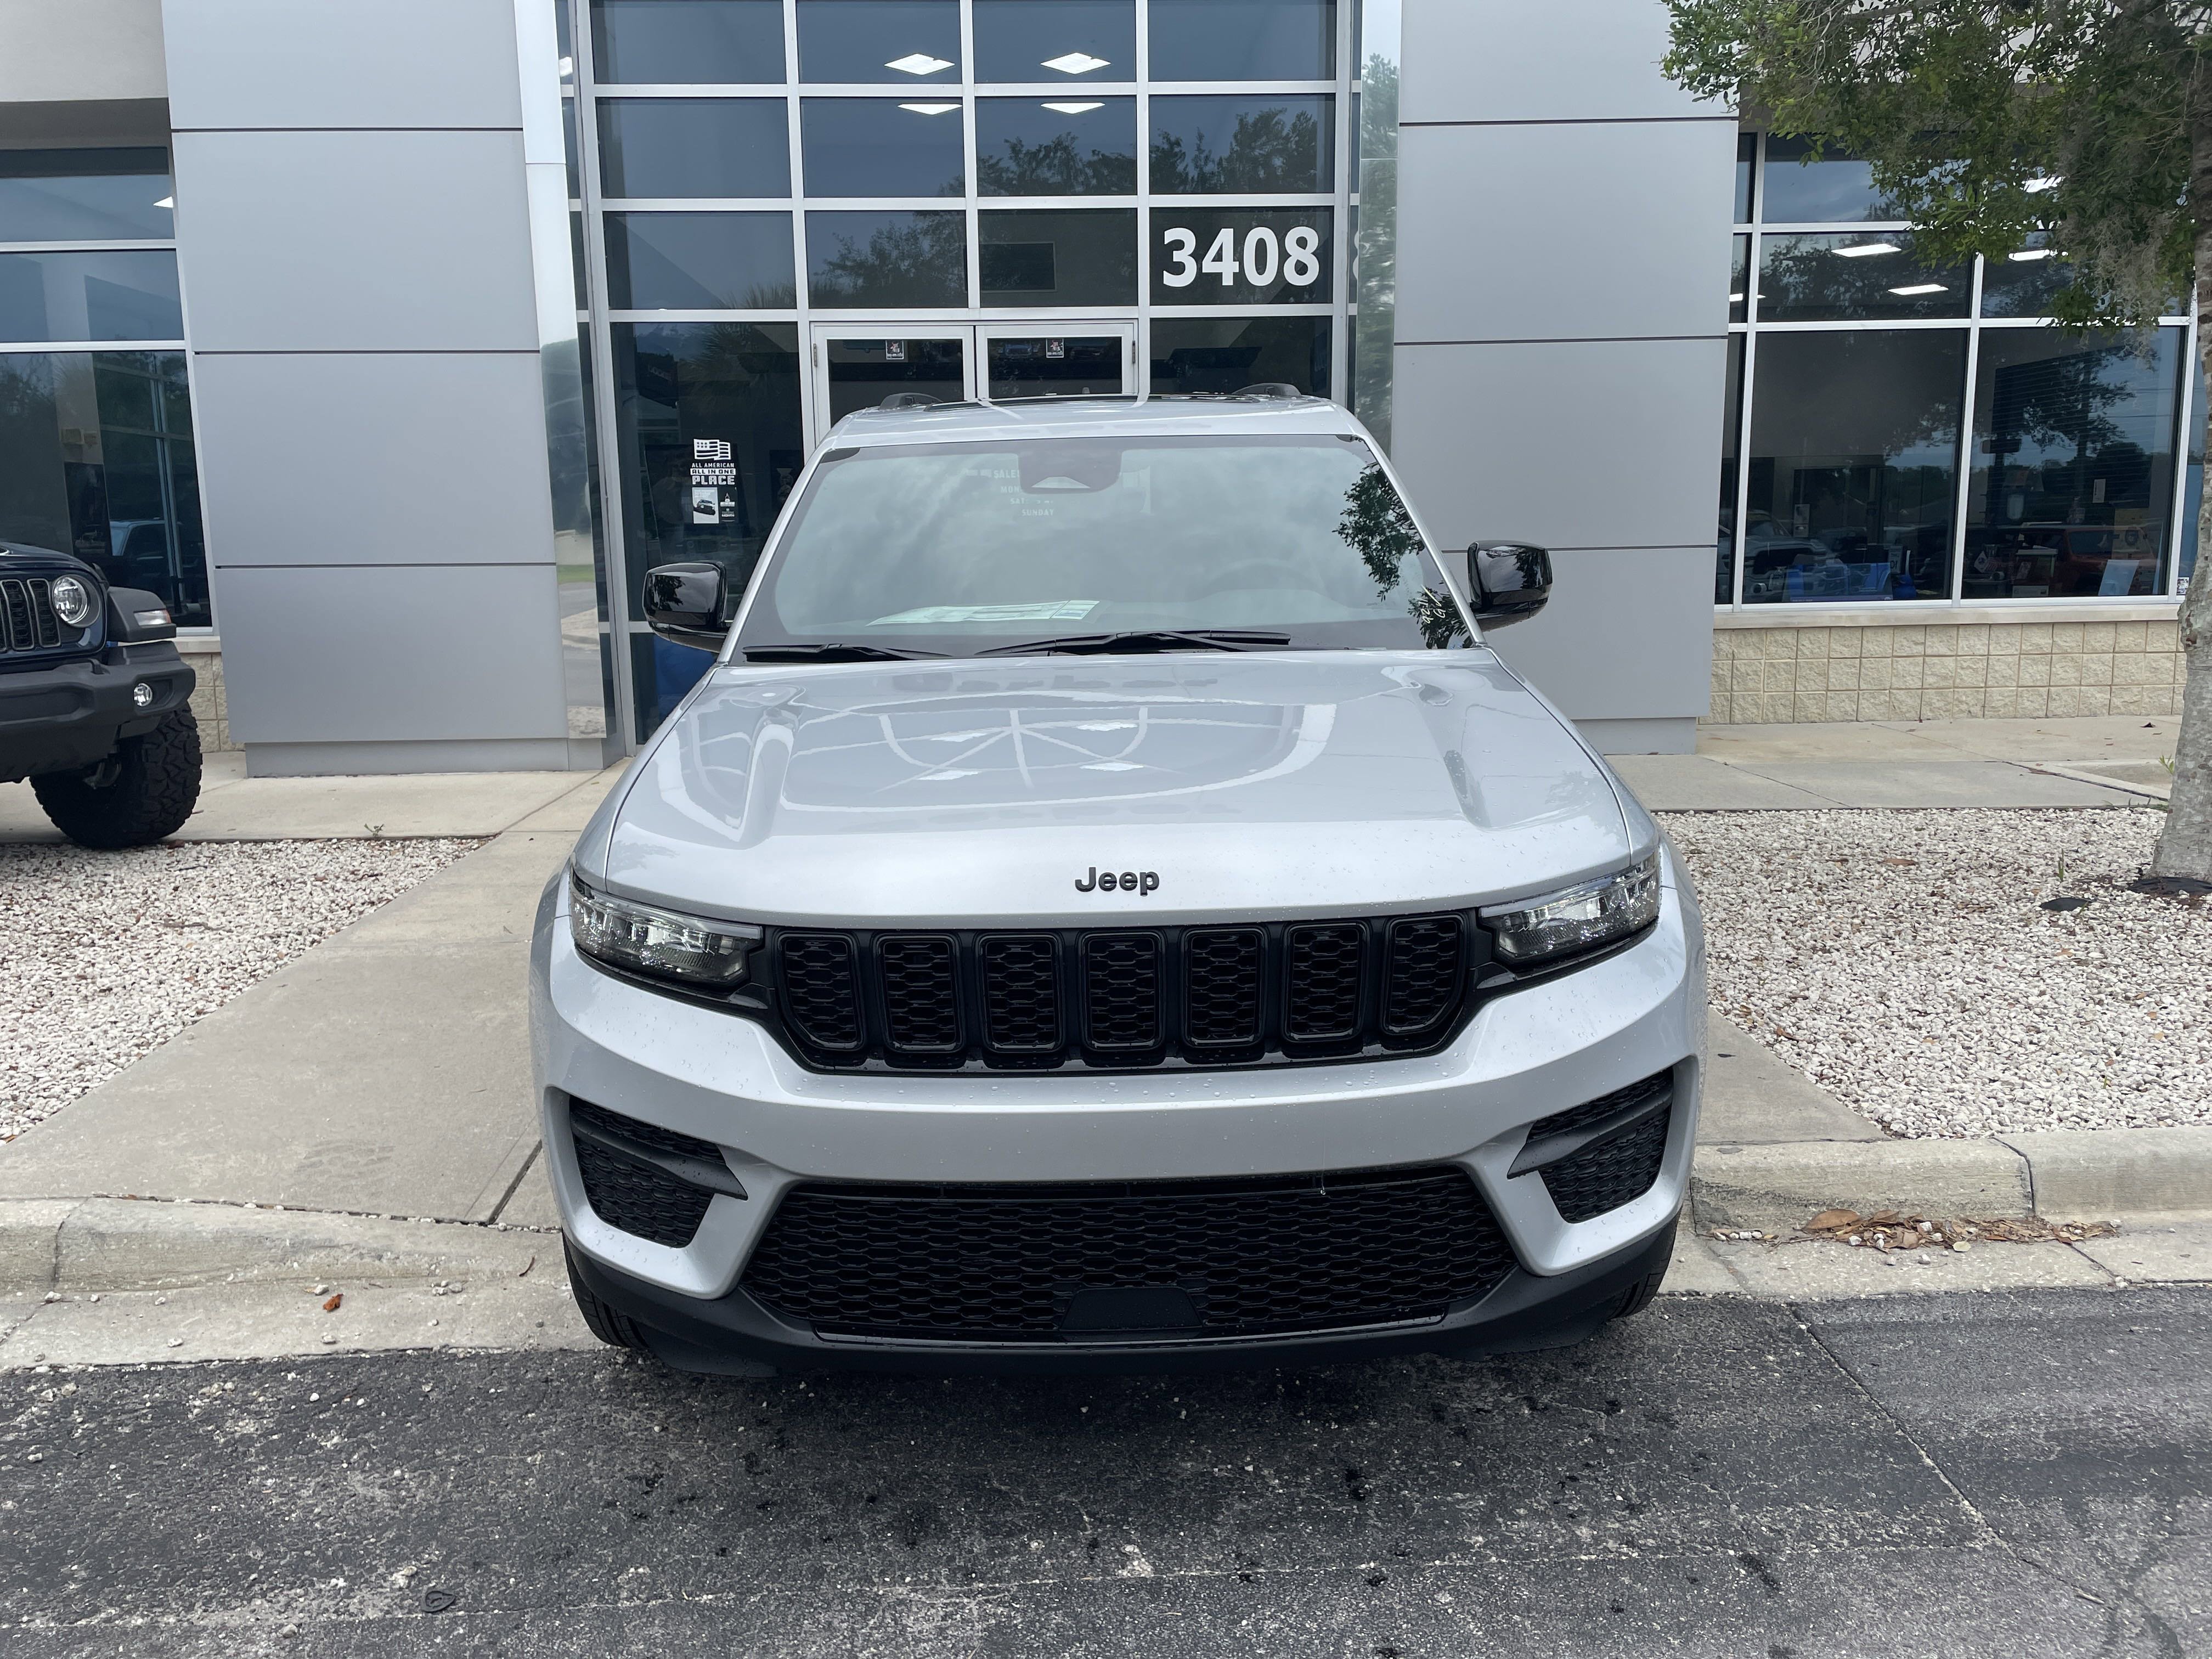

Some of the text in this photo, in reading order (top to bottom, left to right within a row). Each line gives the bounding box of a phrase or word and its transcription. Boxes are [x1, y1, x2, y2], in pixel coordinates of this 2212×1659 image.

[1163, 226, 1319, 287] 3408
[692, 476, 735, 484] PLACE
[1075, 867, 1159, 896] Jeep
